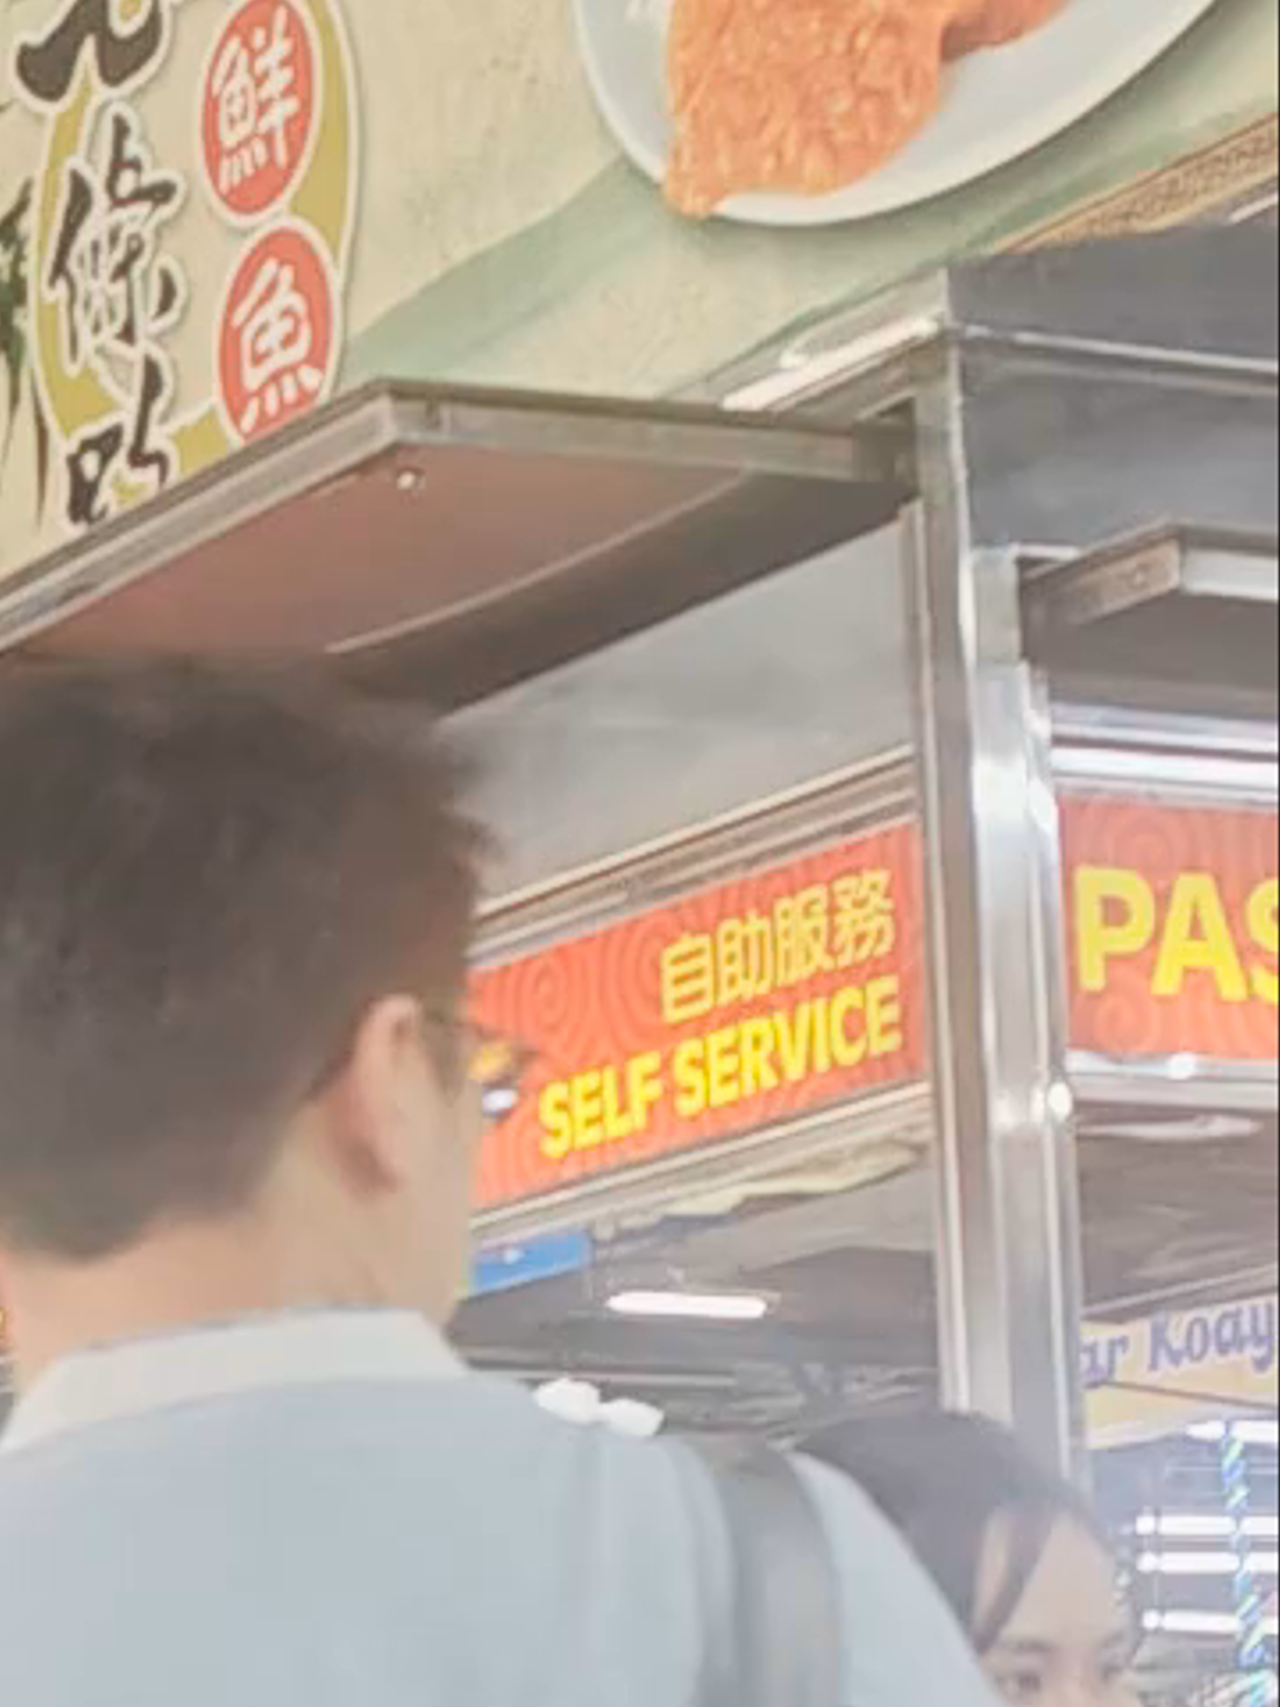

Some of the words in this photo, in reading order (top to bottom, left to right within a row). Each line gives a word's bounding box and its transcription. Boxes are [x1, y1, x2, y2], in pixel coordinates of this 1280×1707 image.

[659, 868, 895, 1023] 自助服務
[538, 1050, 664, 1160] SELF
[672, 974, 903, 1120] SERVICE
